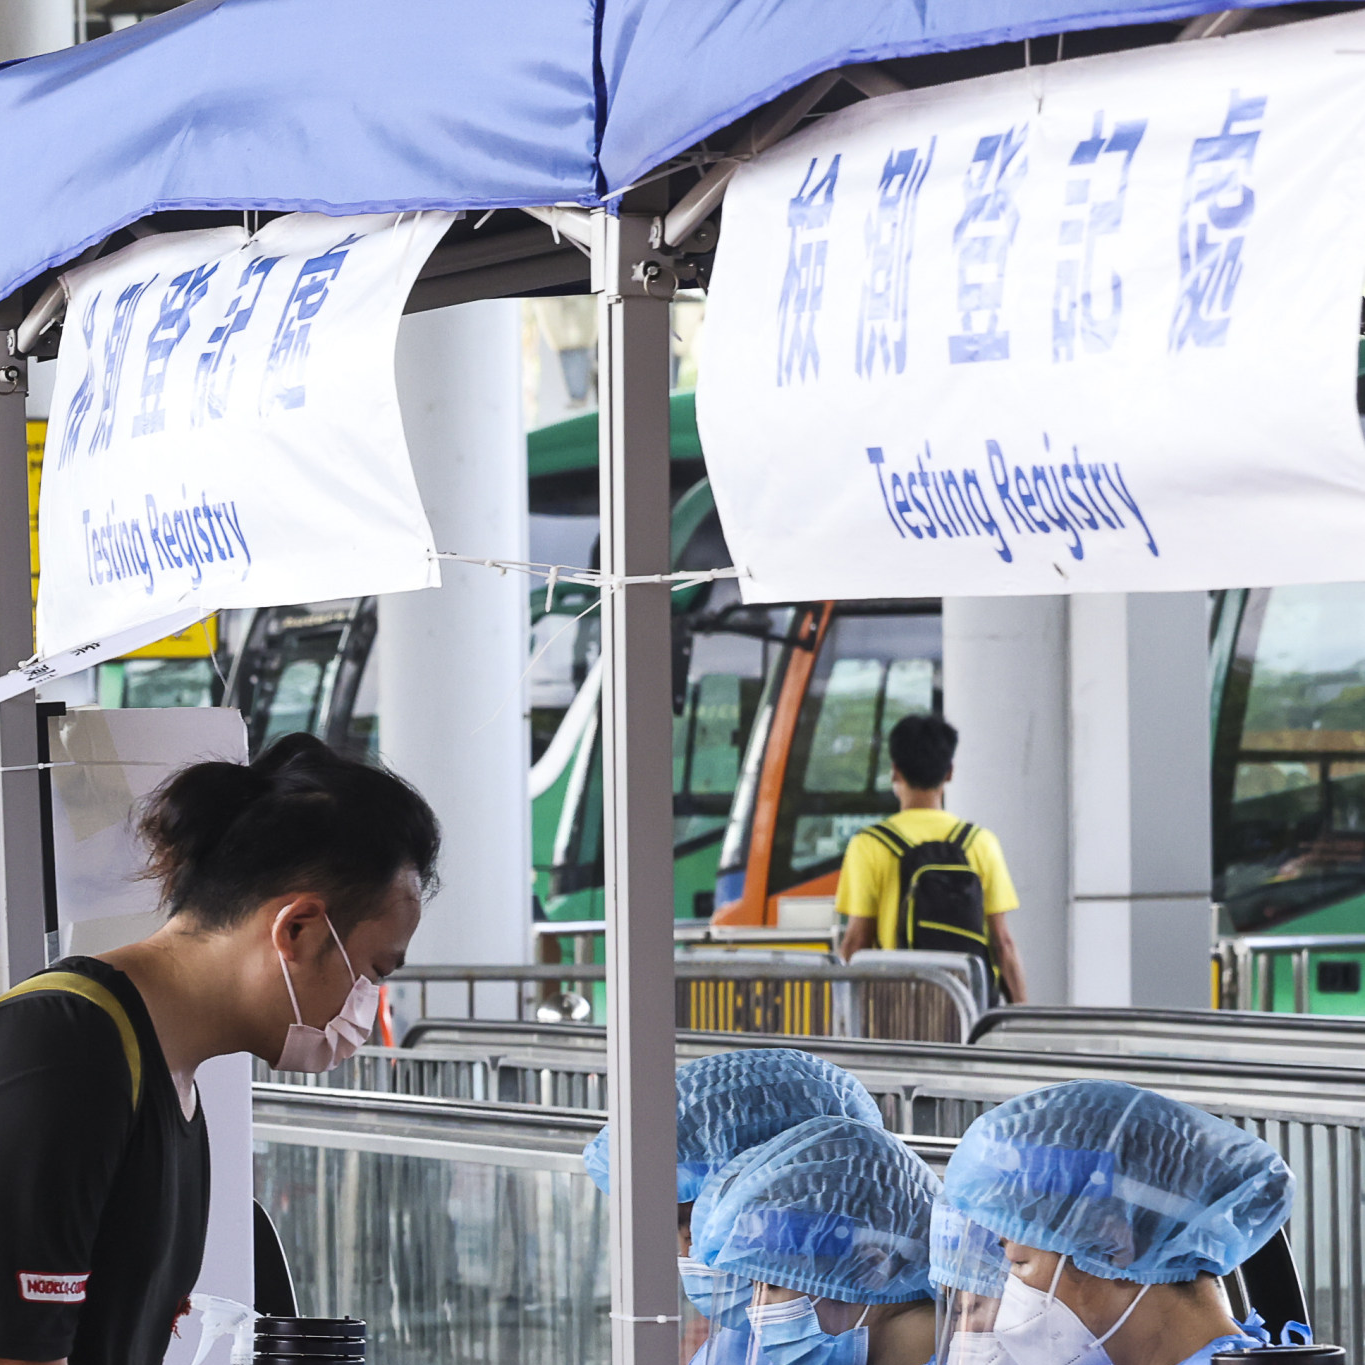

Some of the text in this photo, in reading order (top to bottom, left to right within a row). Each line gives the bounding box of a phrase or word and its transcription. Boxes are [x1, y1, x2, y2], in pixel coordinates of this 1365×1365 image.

[82, 483, 252, 596] Testing Registry
[866, 432, 1160, 563] Testing Registry
